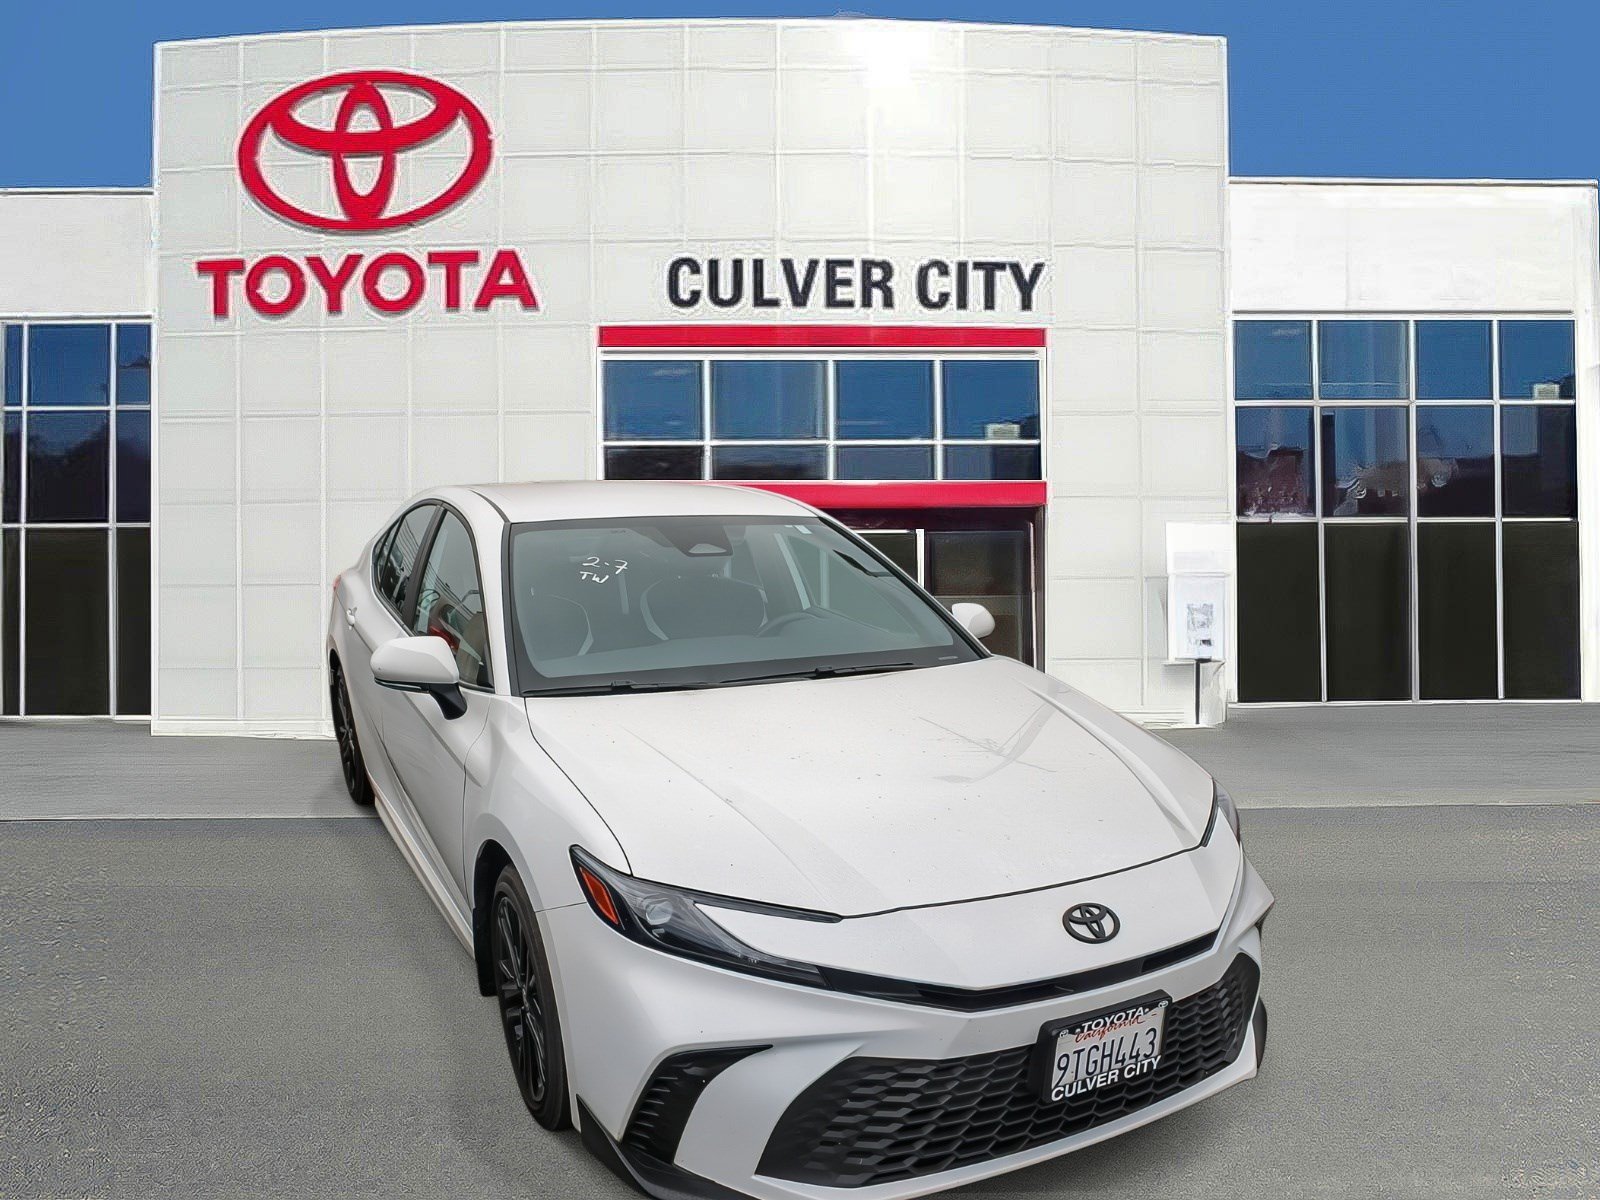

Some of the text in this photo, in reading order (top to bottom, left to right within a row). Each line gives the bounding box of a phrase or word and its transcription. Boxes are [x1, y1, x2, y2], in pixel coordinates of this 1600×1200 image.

[196, 249, 538, 318] TOYOTA
[667, 257, 1046, 311] CULVER CITY
[1081, 1006, 1145, 1033] TOYOTA
[1051, 1055, 1161, 1101] CULVER CITY
[1053, 1027, 1157, 1089] 9TGH443
